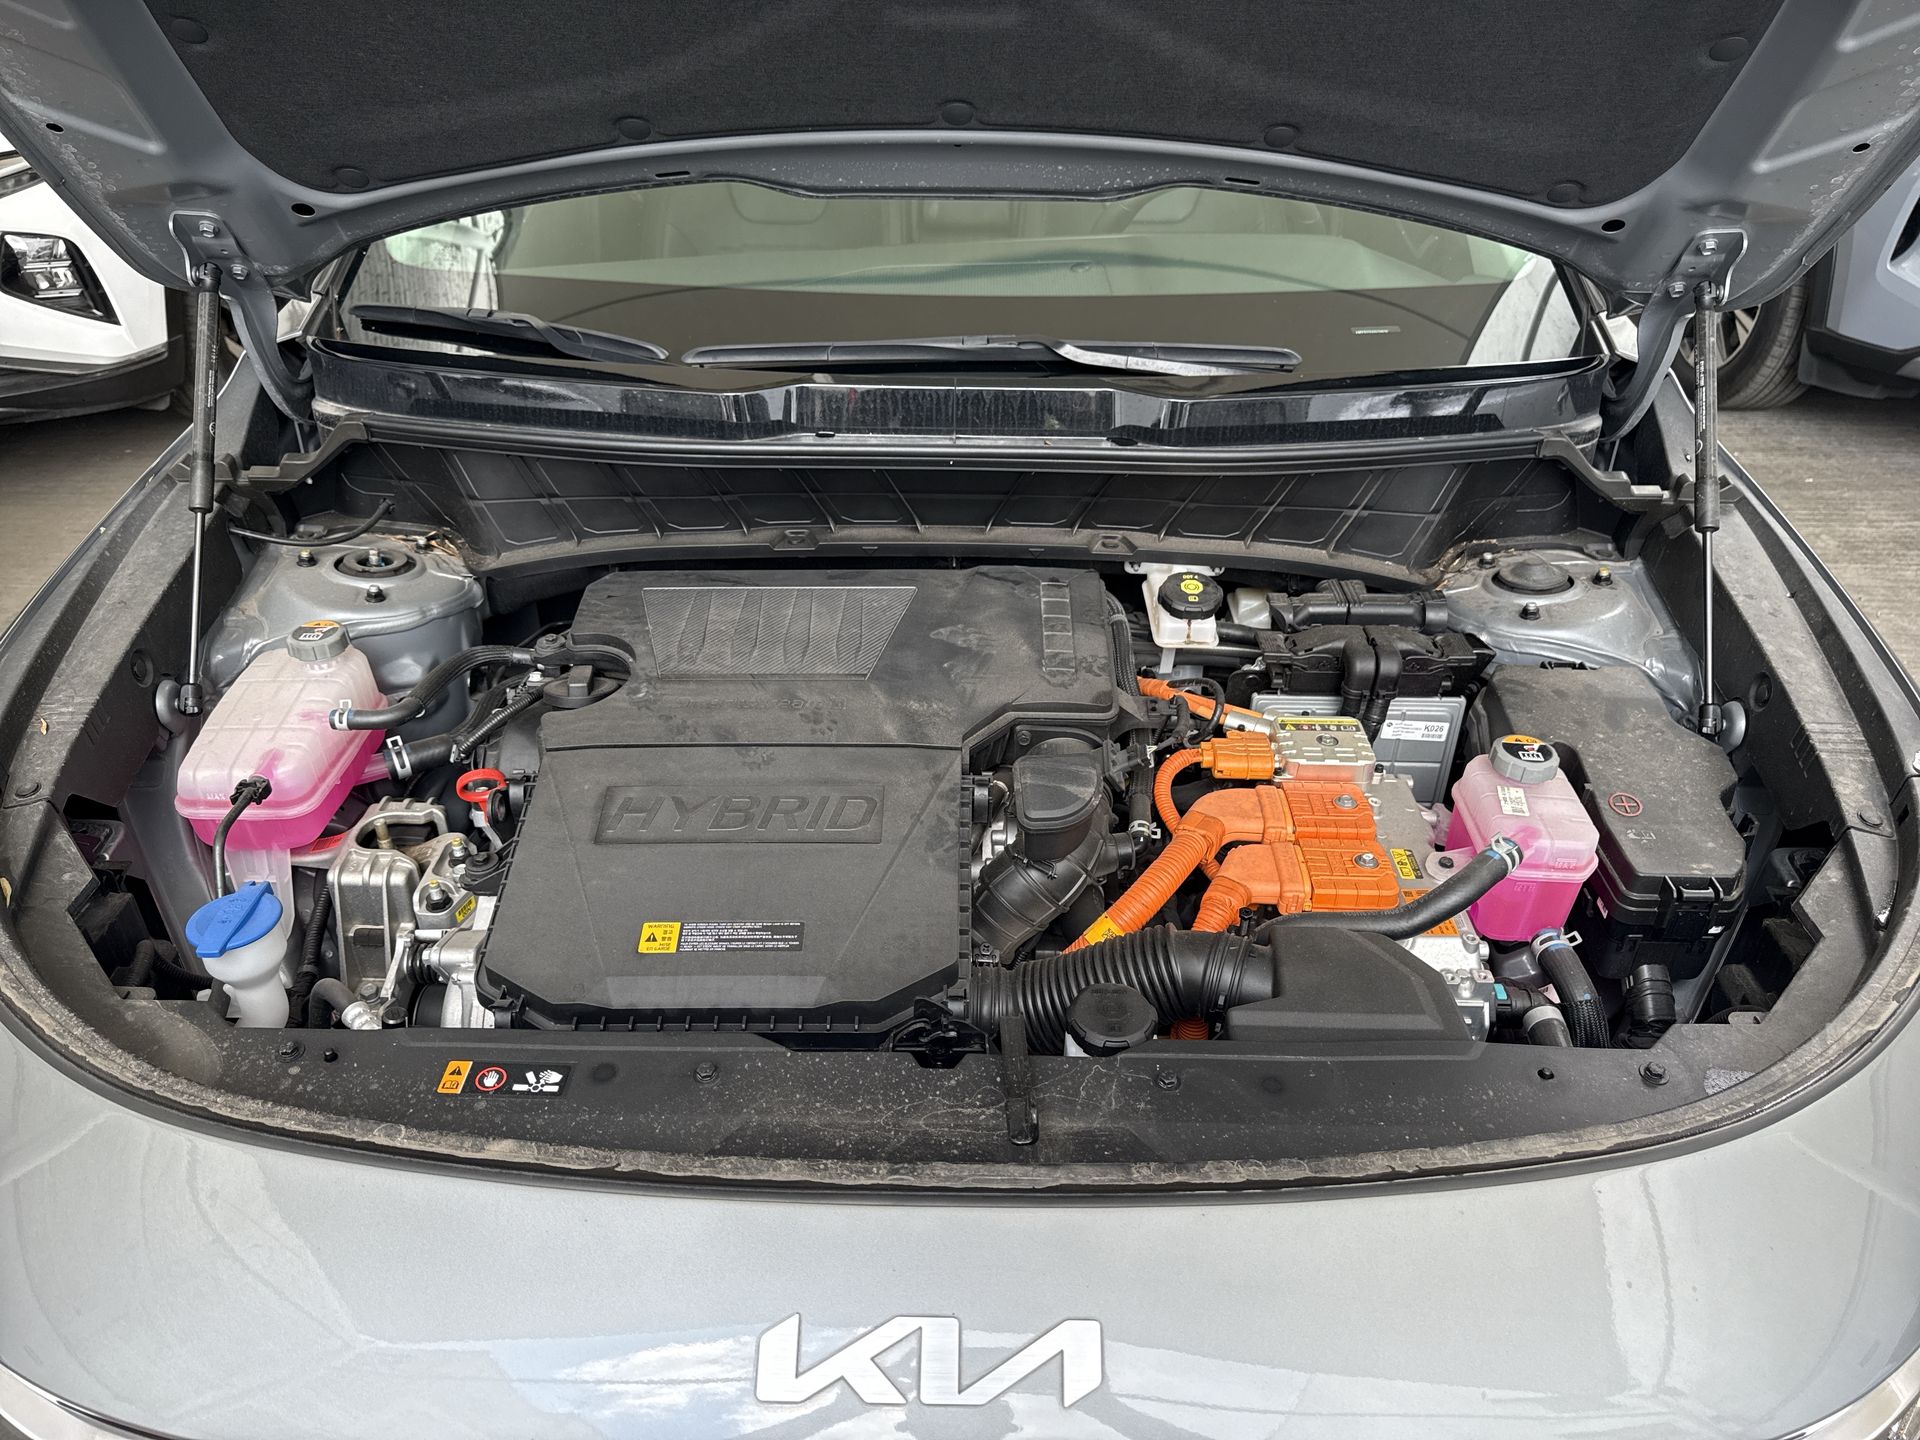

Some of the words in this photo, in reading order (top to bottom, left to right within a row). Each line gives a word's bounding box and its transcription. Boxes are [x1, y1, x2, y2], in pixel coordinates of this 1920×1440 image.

[1424, 724, 1444, 732] K026
[206, 792, 226, 800] MAX
[606, 795, 878, 833] HYBRID
[755, 1312, 1104, 1408] KIA
